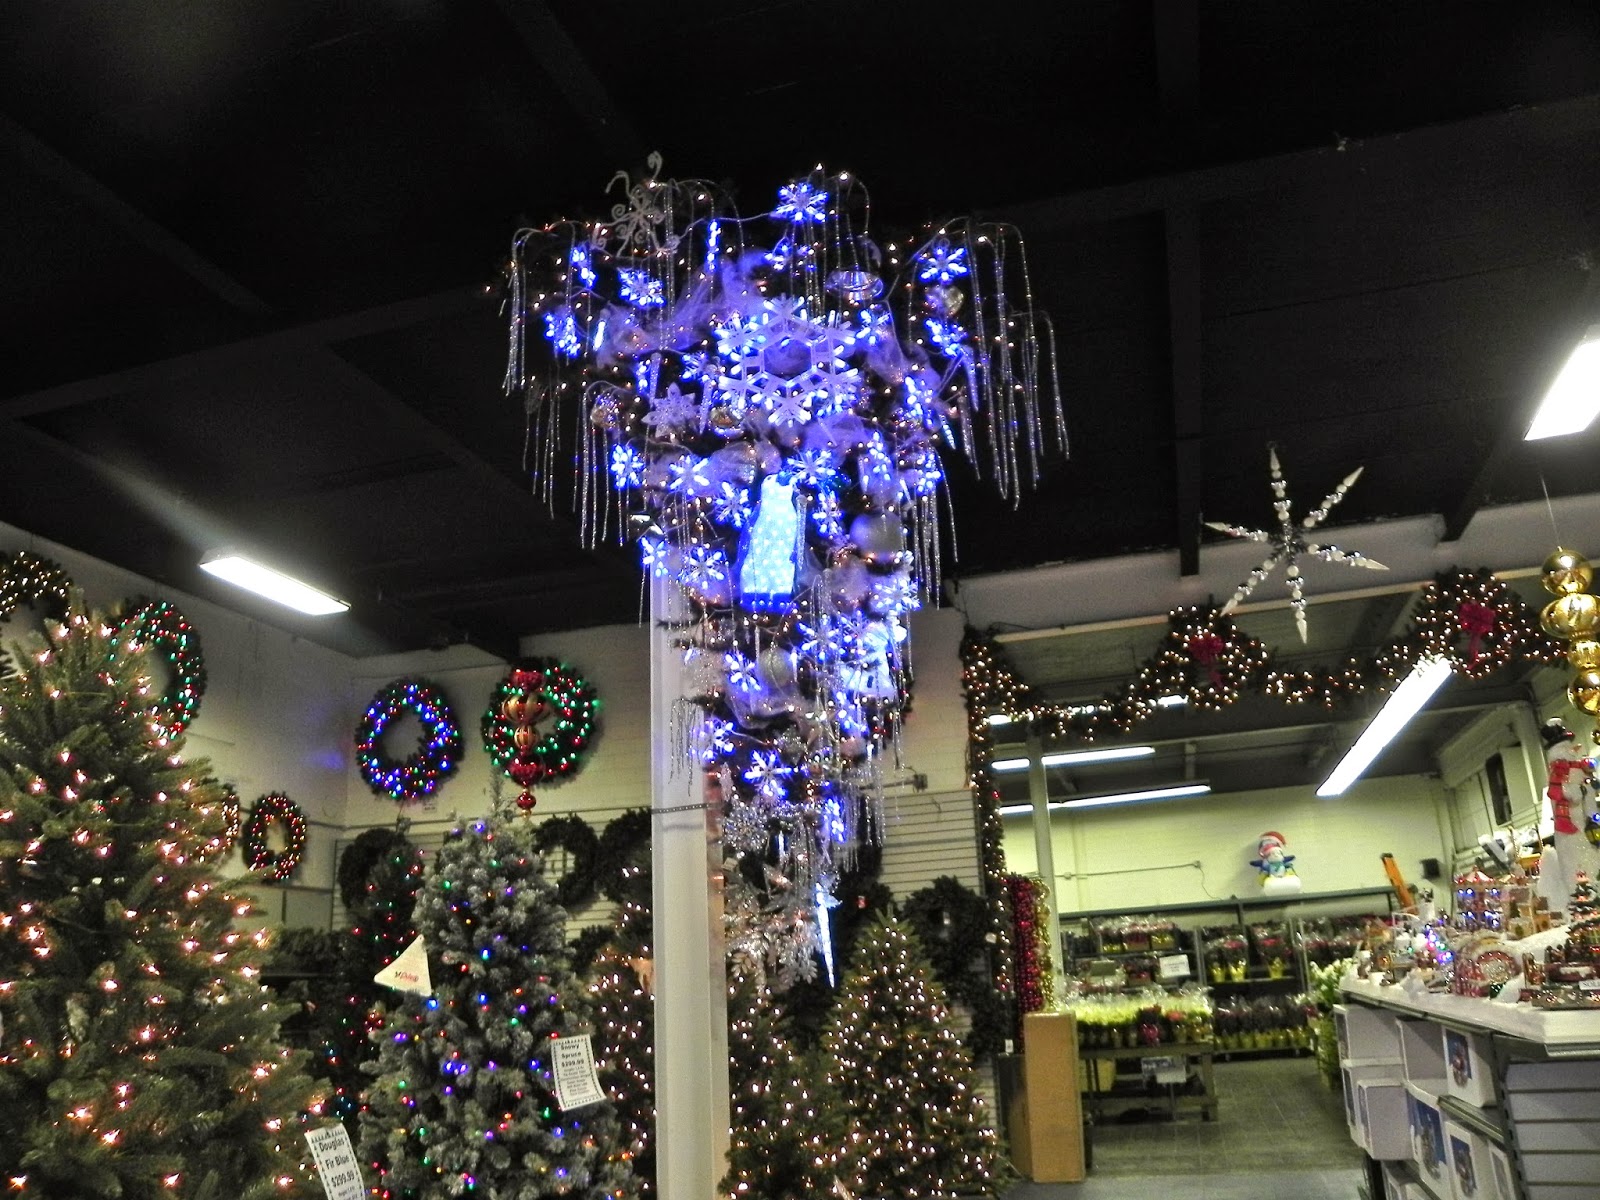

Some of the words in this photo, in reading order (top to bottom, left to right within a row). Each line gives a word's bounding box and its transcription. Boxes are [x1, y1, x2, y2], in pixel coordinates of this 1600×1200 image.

[318, 1138, 344, 1152] Douglas
[325, 1159, 334, 1169] Fir
[334, 1155, 350, 1166] Blue
